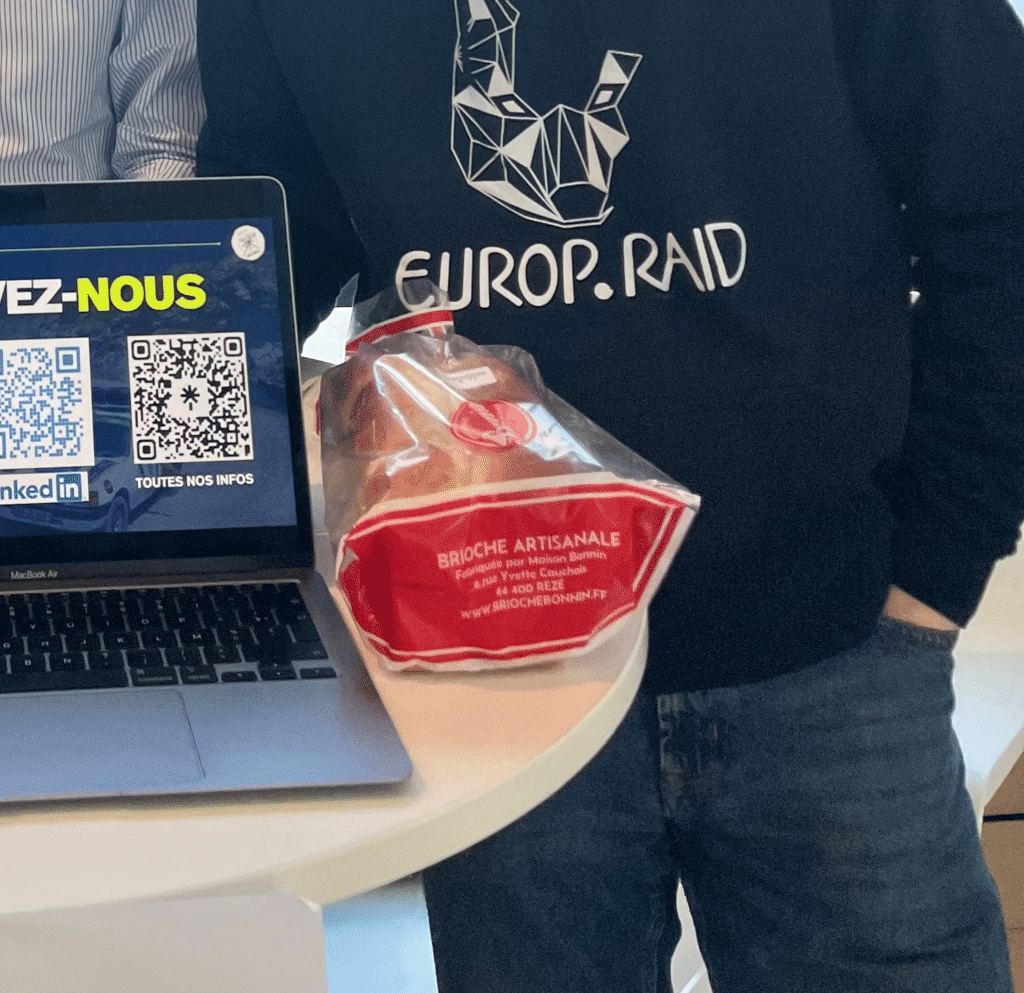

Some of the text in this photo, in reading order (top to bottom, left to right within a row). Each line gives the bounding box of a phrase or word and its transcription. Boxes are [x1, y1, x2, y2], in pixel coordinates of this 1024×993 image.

[395, 221, 747, 313] EUROP.RAID
[135, 473, 255, 489] TOUTES NOS INFOS
[437, 530, 621, 570] BRIOCHE ARTISANALE
[505, 558, 525, 569] par
[528, 554, 567, 565] Maison
[10, 569, 59, 580] MacBook Air
[500, 570, 536, 581] Yvette
